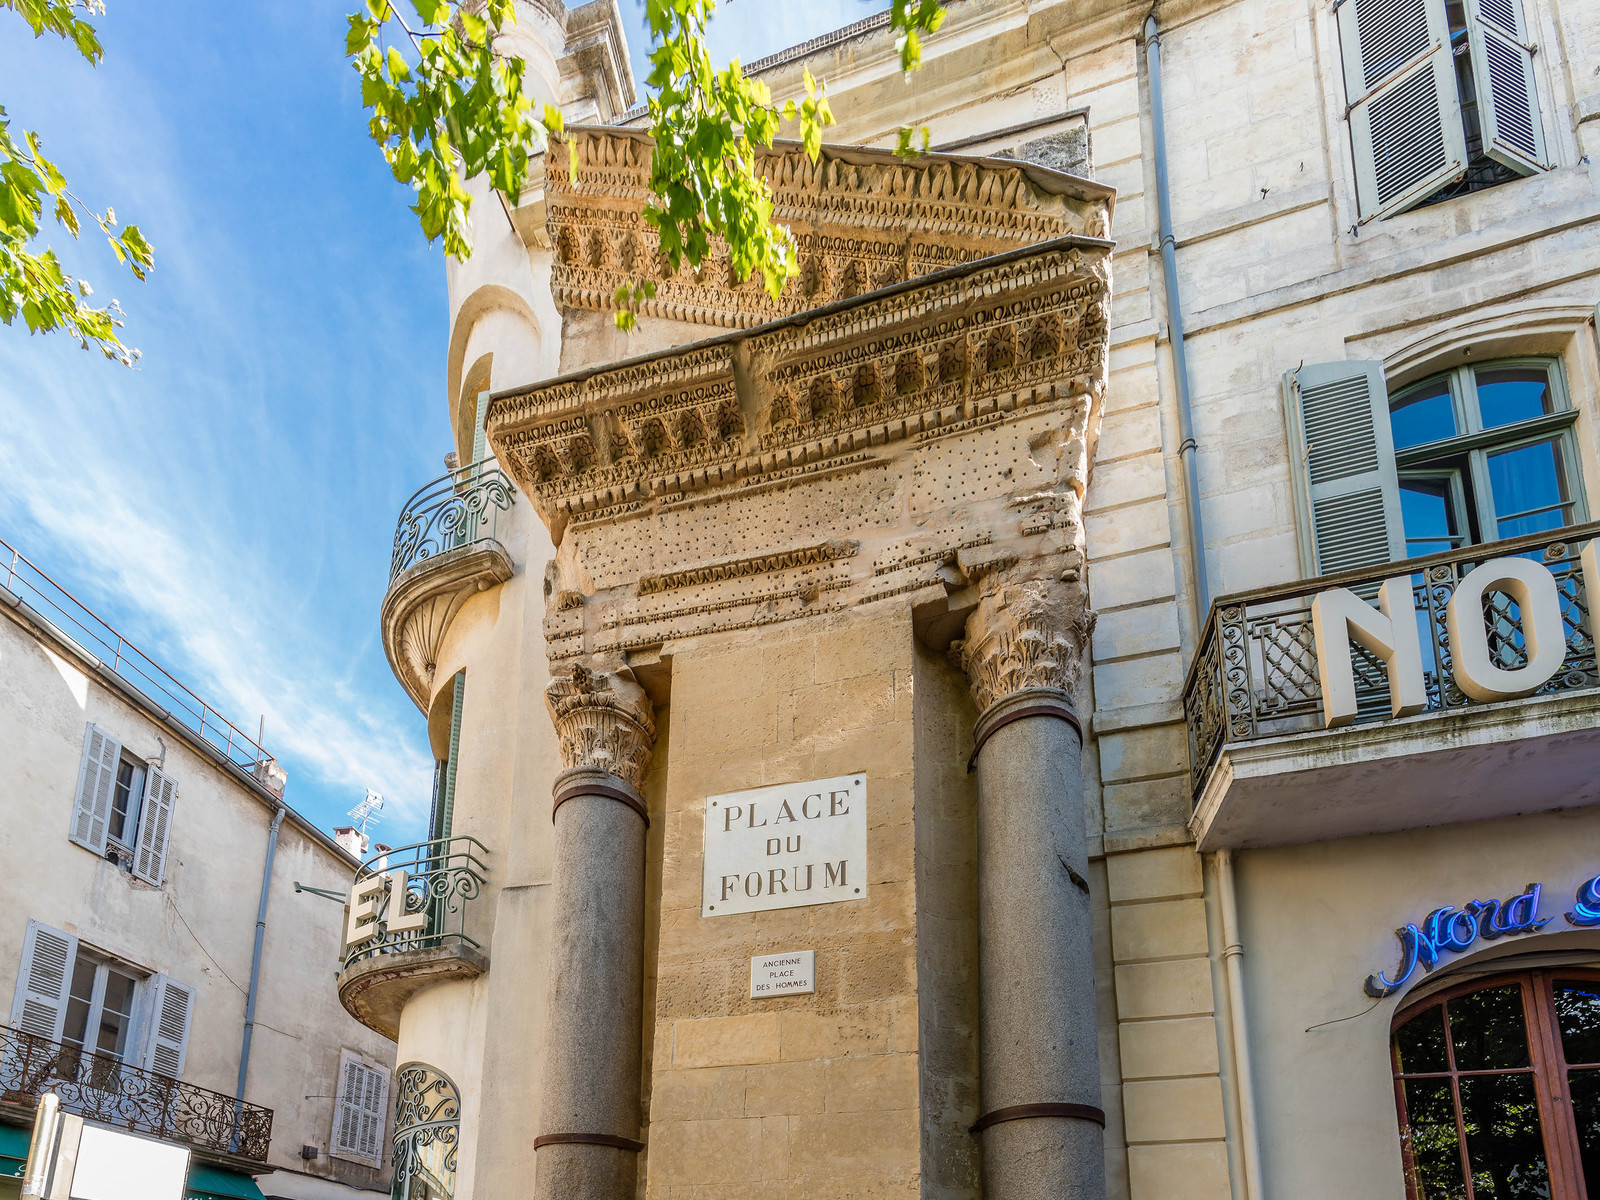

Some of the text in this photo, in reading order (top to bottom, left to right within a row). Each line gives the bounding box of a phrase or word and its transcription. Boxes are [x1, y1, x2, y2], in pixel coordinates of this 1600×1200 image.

[1311, 538, 1600, 728] NO
[723, 789, 850, 832] PLACE
[766, 835, 801, 856] DU
[719, 860, 849, 901] FORUM
[1365, 883, 1554, 998] Nord
[762, 958, 802, 968] ANCIENNE
[769, 970, 795, 978] PLACE
[775, 980, 808, 989] HOMMES
